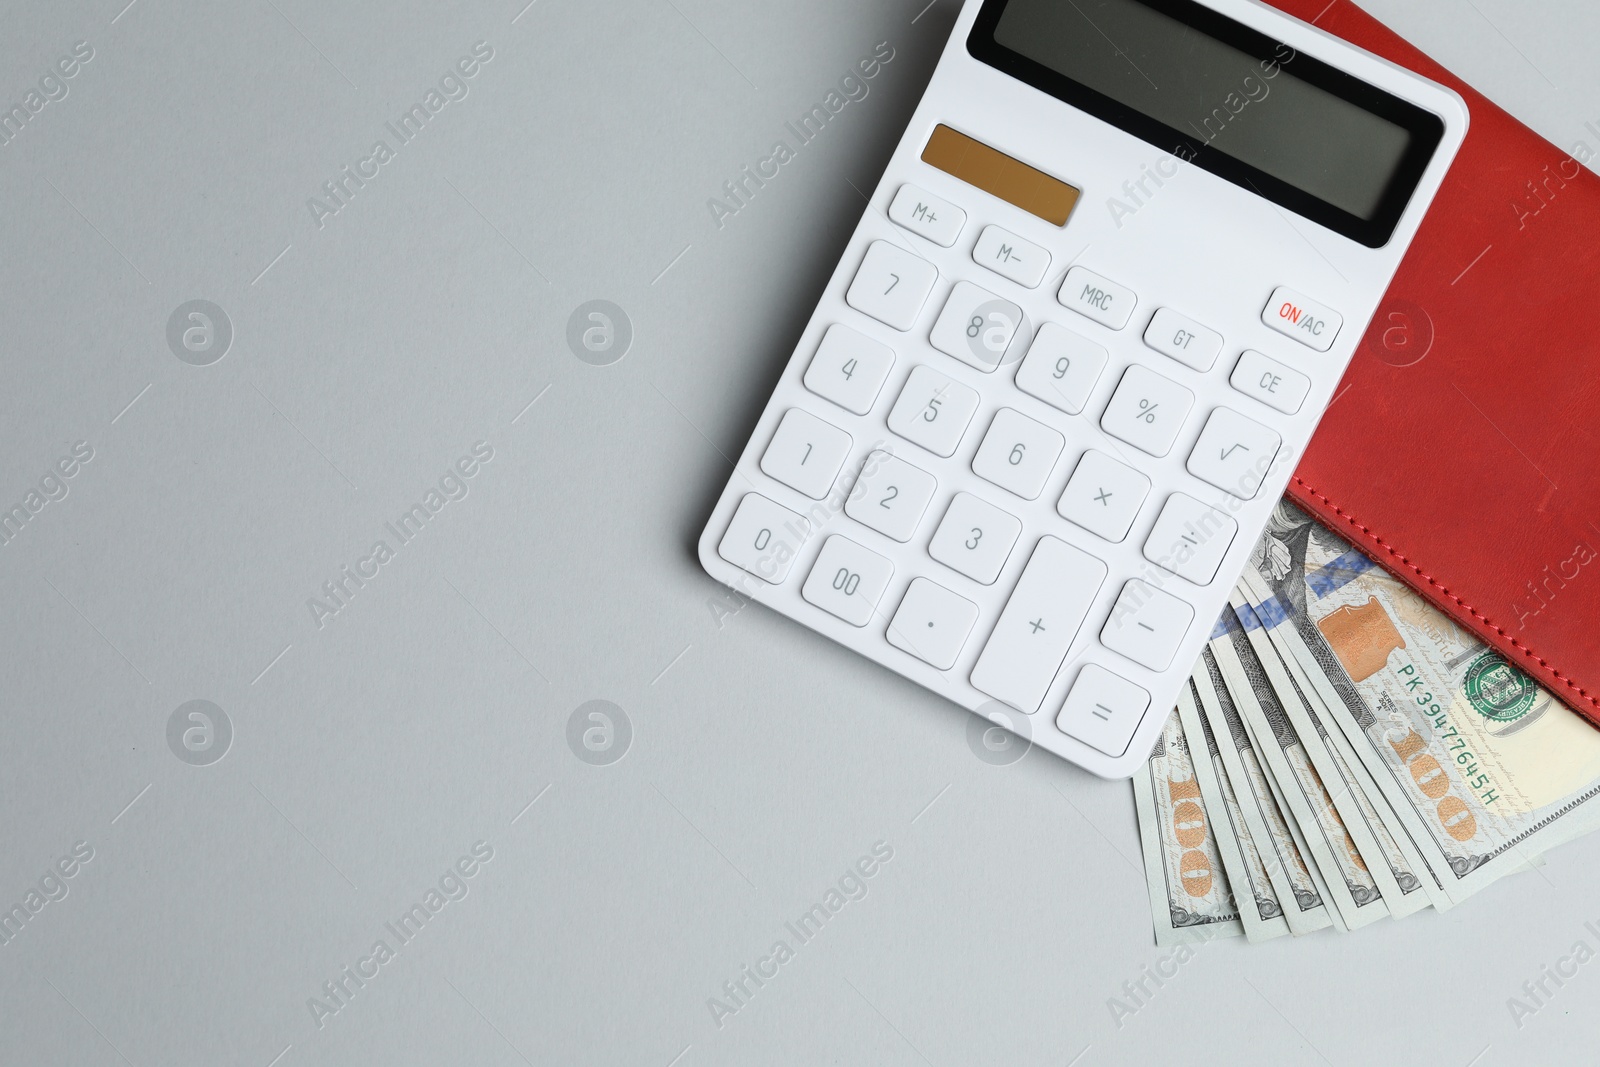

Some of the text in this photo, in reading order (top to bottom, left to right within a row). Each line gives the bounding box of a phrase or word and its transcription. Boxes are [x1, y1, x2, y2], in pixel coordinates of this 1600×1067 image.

[912, 202, 938, 225] M+
[883, 273, 900, 295] 7
[1080, 284, 1113, 311] MRC
[966, 315, 984, 338] 8
[1279, 302, 1325, 336] ON/AC
[1172, 330, 1196, 350] GT
[842, 359, 858, 381] 4
[1053, 356, 1071, 380] 9
[1259, 372, 1282, 394] CE
[923, 398, 942, 423] 5
[1137, 399, 1156, 424] %
[801, 443, 813, 466] 1
[1008, 443, 1026, 466] 6
[880, 486, 899, 510] 2
[754, 528, 772, 551] 0
[965, 528, 983, 551] 3
[832, 567, 861, 597] 00
[1378, 697, 1392, 712] 2017
[1380, 690, 1398, 714] SERIES
[1176, 735, 1184, 752] 2017
[1387, 725, 1477, 842] 100
[1166, 772, 1213, 898] 100
